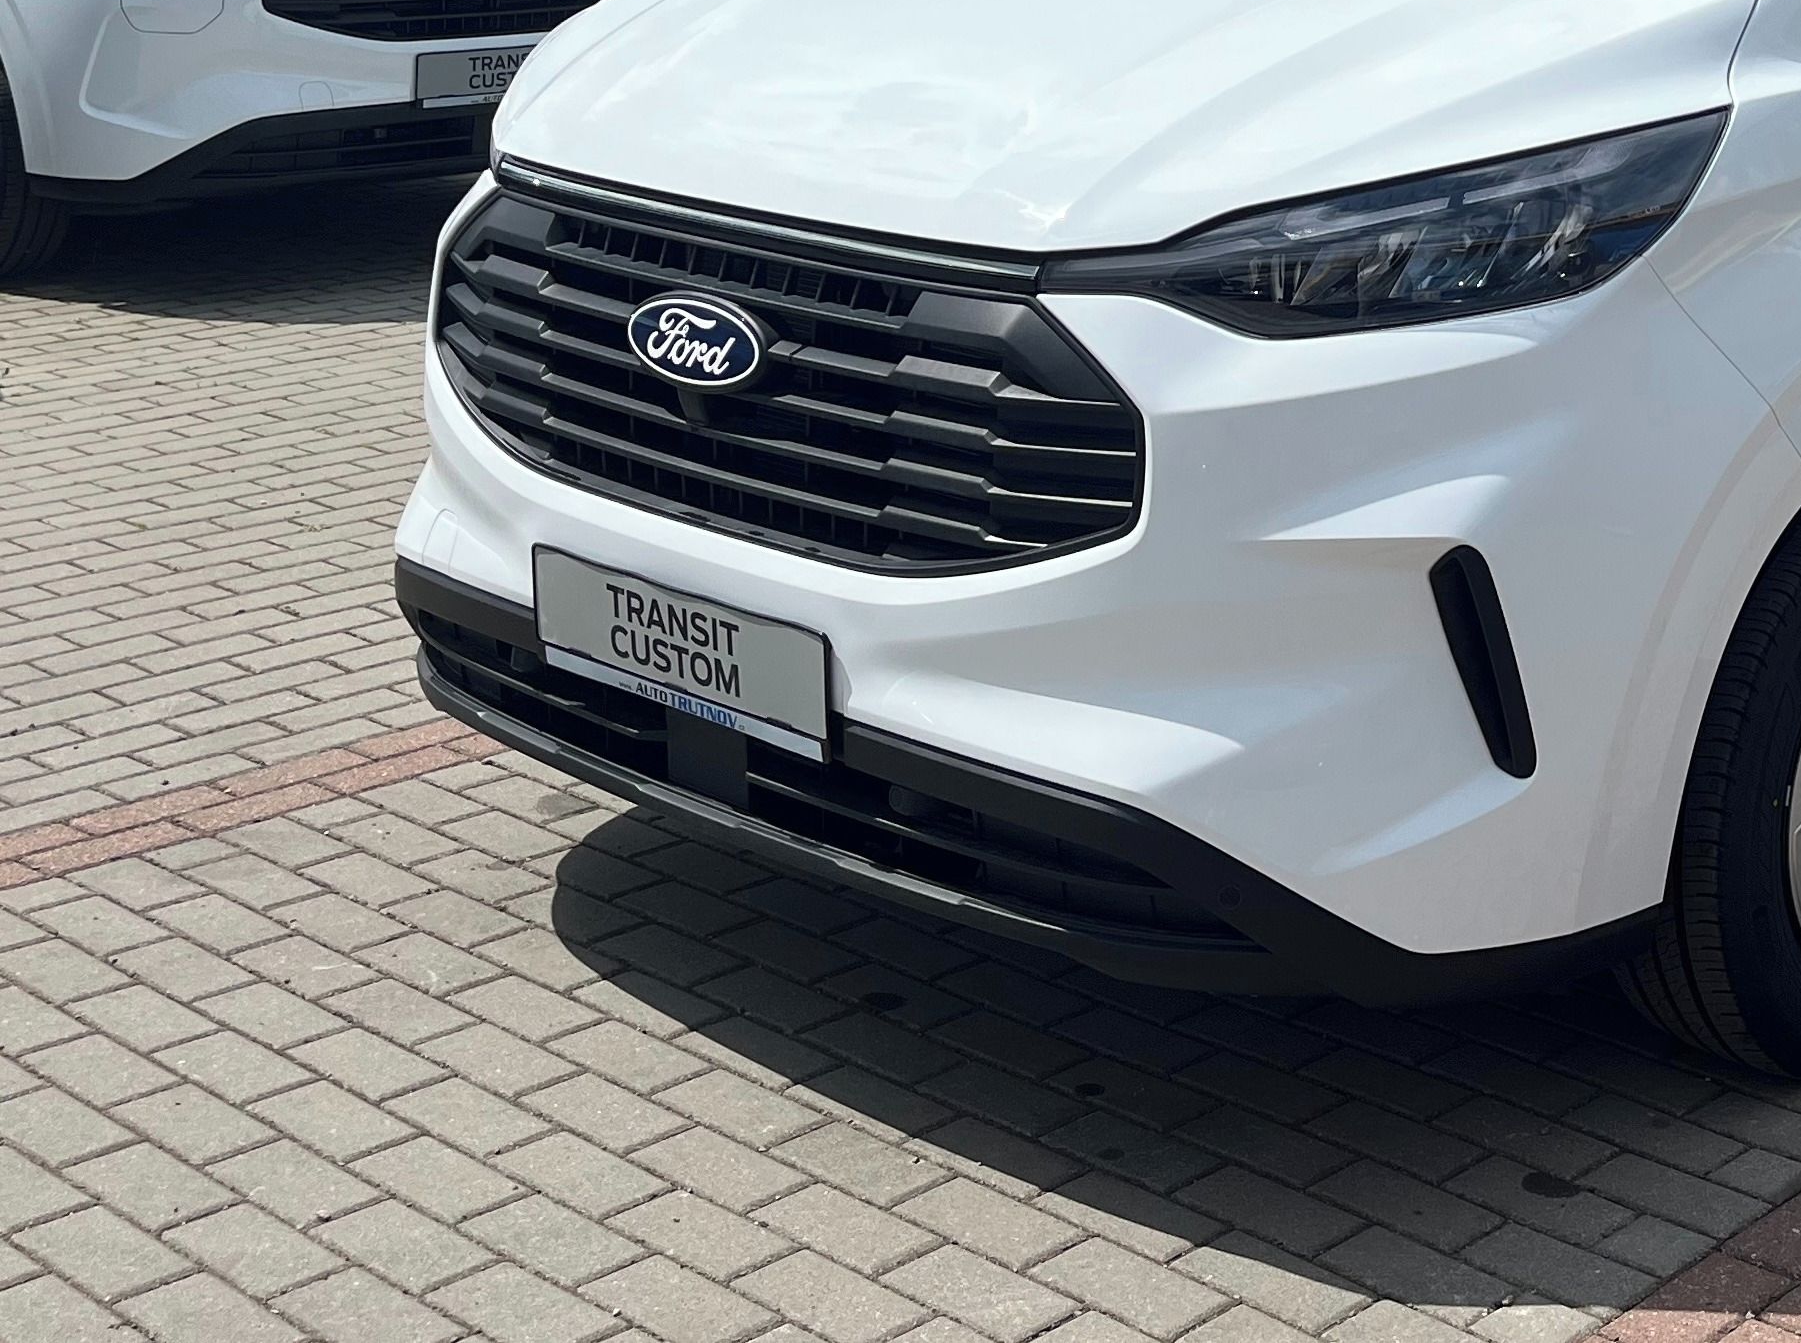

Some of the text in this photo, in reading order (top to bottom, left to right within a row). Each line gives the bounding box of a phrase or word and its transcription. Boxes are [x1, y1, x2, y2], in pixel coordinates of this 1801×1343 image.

[646, 307, 736, 375] Ford
[606, 583, 740, 657] TRANSIT
[610, 625, 742, 698] CUSTOM
